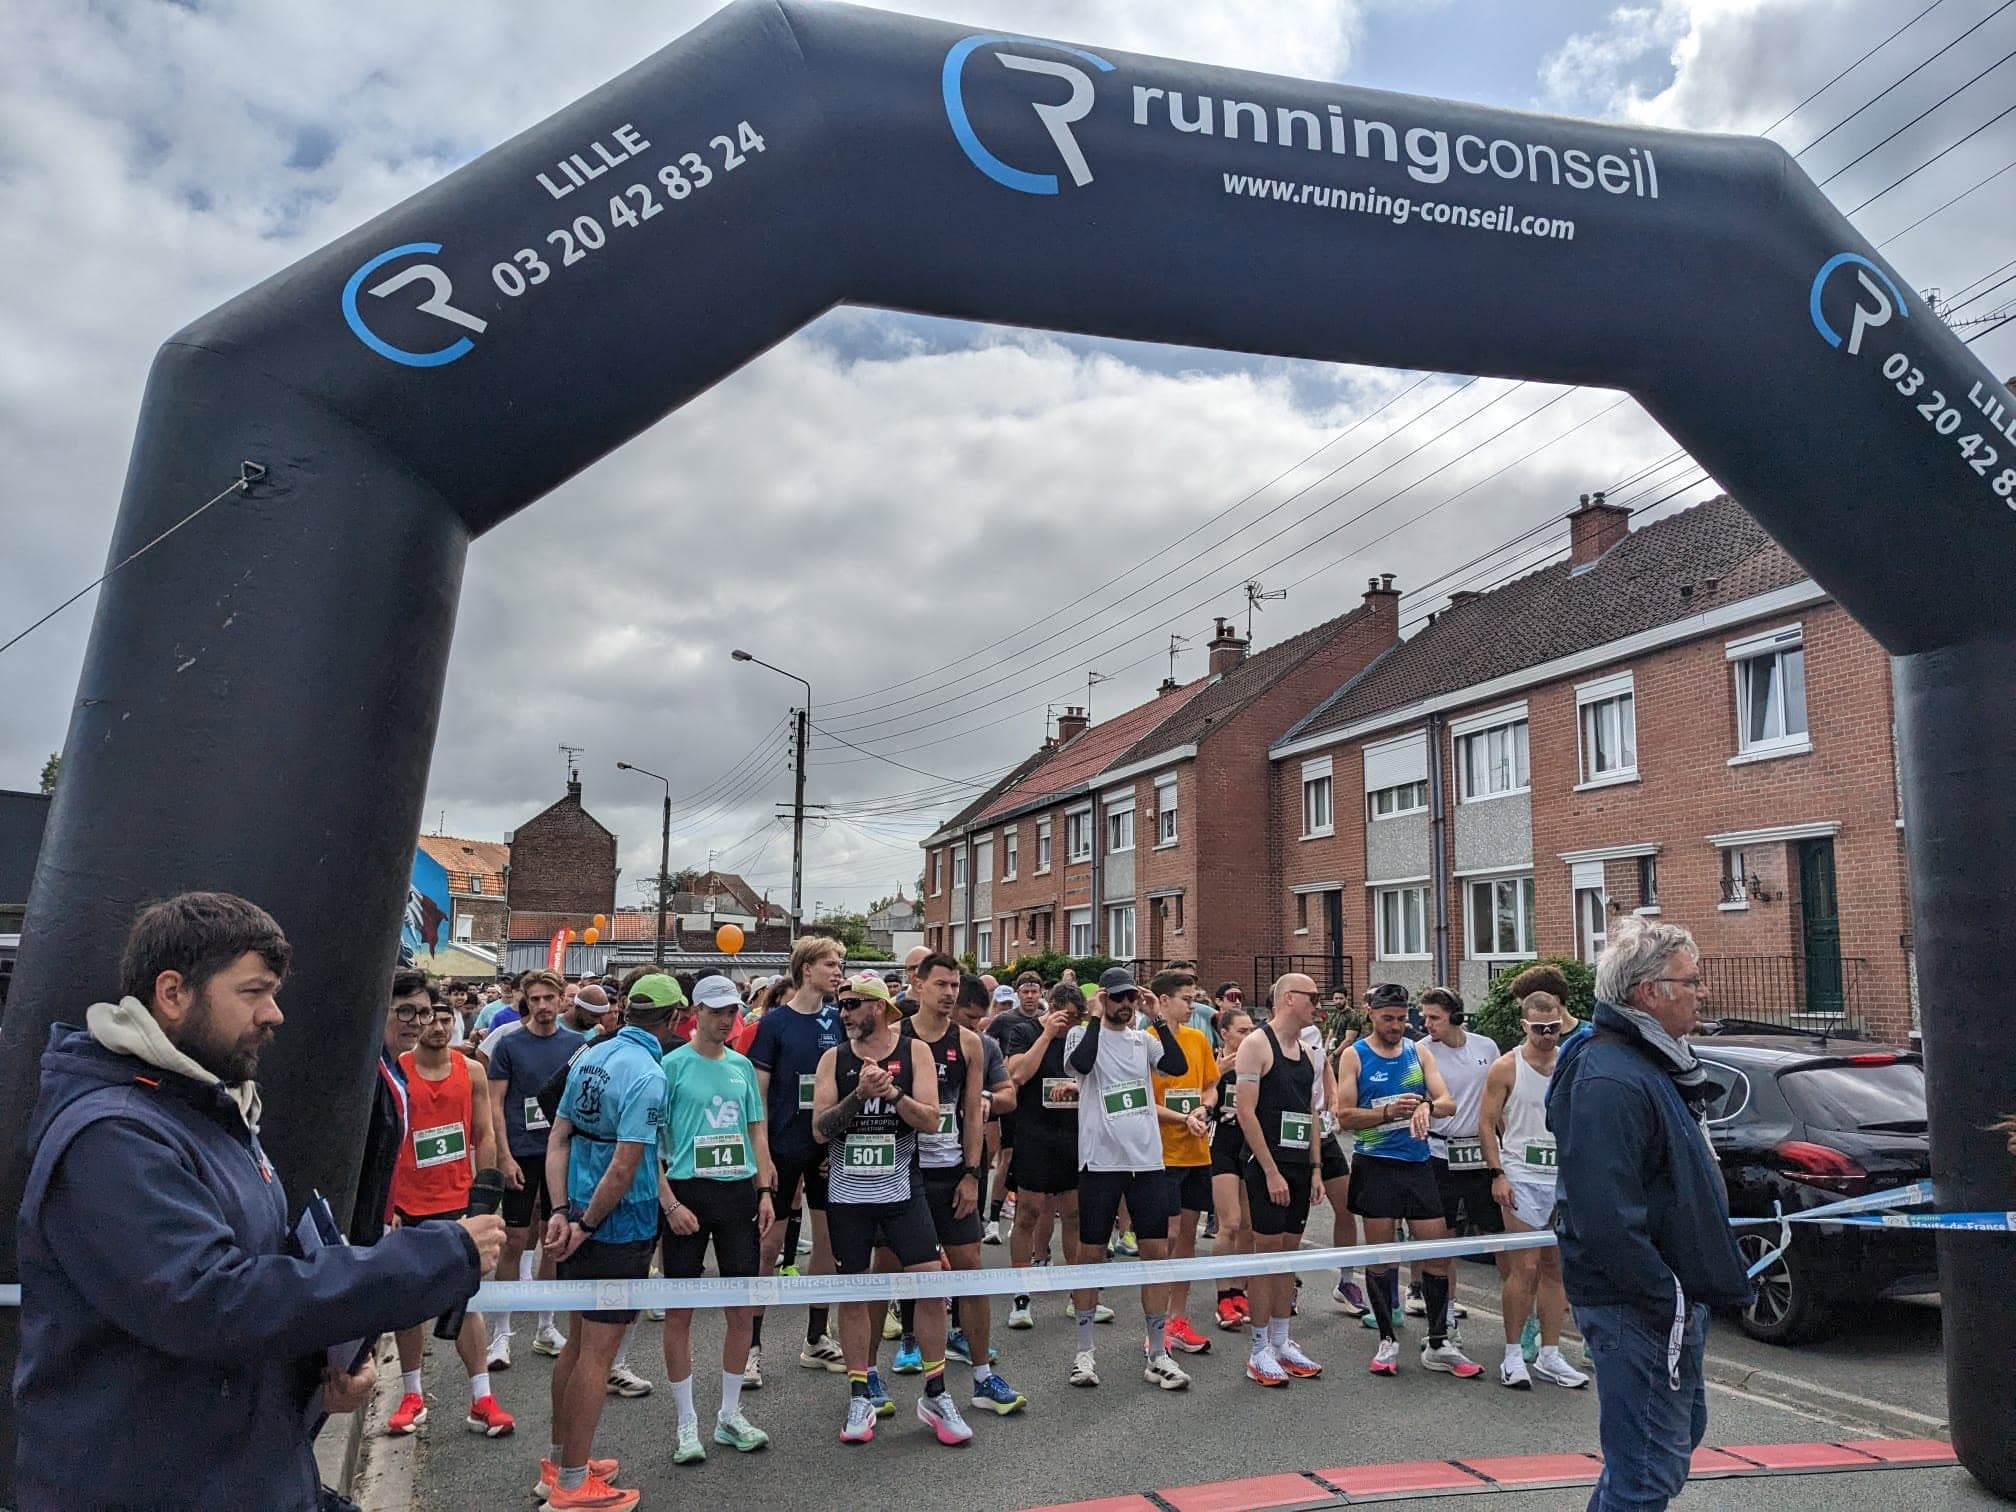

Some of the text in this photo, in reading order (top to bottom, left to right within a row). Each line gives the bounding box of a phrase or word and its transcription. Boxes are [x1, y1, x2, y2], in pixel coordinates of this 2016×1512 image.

[1132, 84, 1659, 199] runningconseil
[536, 123, 651, 200] LILLE
[491, 120, 767, 297] 03 20 42 83 24
[1223, 173, 1576, 241] www.running-conseil.com
[1882, 353, 1925, 396] 03
[1916, 390, 1962, 435] 20
[1957, 433, 1998, 477] 42
[1122, 1093, 1133, 1109] 6
[1181, 1099, 1191, 1114] 9
[1297, 1125, 1305, 1140] 5
[435, 1138, 447, 1155] 3
[852, 1147, 883, 1165] 501
[711, 1147, 733, 1166] 14
